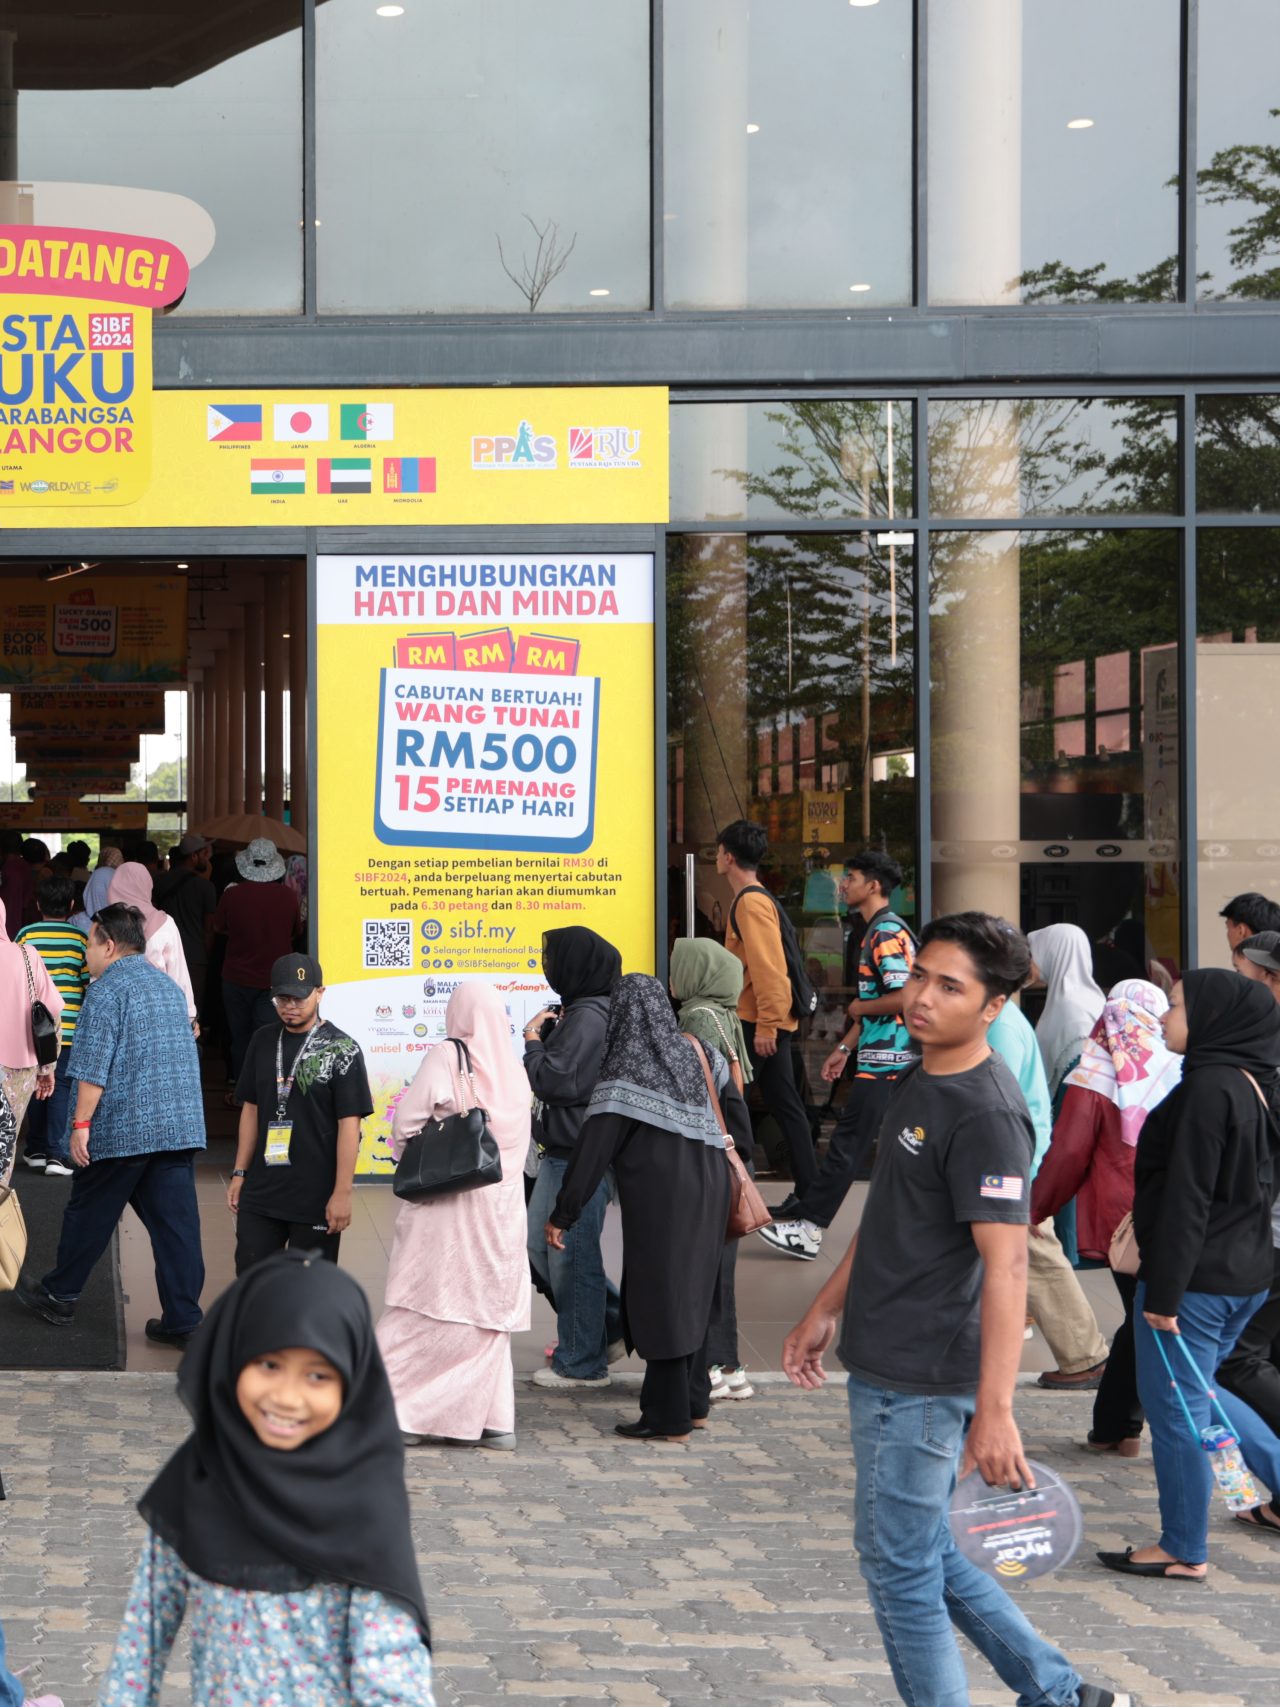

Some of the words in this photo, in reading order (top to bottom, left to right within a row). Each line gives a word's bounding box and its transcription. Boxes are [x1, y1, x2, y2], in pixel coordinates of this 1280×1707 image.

[92, 317, 130, 332] SIBF
[92, 333, 132, 346] 2024
[473, 433, 555, 462] PPAS
[356, 565, 615, 587] MENGHUBUNGKAN
[354, 591, 424, 616] HATI
[436, 591, 501, 616] DAN
[513, 590, 619, 615] MINDA
[80, 618, 111, 632] 500
[3, 632, 46, 644] BOOK
[58, 632, 74, 646] 15
[4, 645, 32, 656] FAIR
[408, 646, 445, 665] RM
[464, 643, 504, 667] RM
[527, 647, 565, 670] RM
[395, 685, 483, 701] CABUTAN
[491, 689, 582, 706] BERTUAH!
[395, 702, 486, 724] WANG
[494, 707, 580, 728] TUNAI
[396, 729, 576, 774] RM500
[395, 775, 441, 812] 15
[447, 778, 576, 798] PEMENANG
[444, 797, 514, 814] SETIAP
[522, 800, 574, 817] HARI
[368, 858, 411, 870] Dengan
[414, 858, 449, 870] setiap
[452, 858, 513, 869] pembelian
[516, 858, 560, 868] bernilai
[563, 858, 594, 868] RM30
[597, 858, 608, 868] di
[354, 873, 411, 884] SIBF2024,
[414, 872, 442, 882] anda
[446, 872, 511, 883] berpeluang
[514, 872, 572, 883] menyertai
[576, 872, 622, 882] cabutan
[360, 887, 409, 896] bertuah.
[413, 887, 473, 898] Pemenang
[476, 886, 513, 896] harian
[516, 886, 544, 896] akan
[547, 886, 616, 896] diumumkan
[390, 901, 418, 912] pada
[422, 901, 445, 910] 6.30
[449, 901, 488, 912] petang
[491, 900, 512, 910] dan
[516, 901, 539, 910] 8.30
[543, 900, 585, 910] malam.
[450, 920, 515, 943] sibf.my
[434, 946, 471, 956] Selangor
[474, 946, 525, 954] International
[529, 946, 543, 954] Boo
[457, 959, 520, 969] @SIBFSelangor
[370, 1043, 401, 1052] unisel
